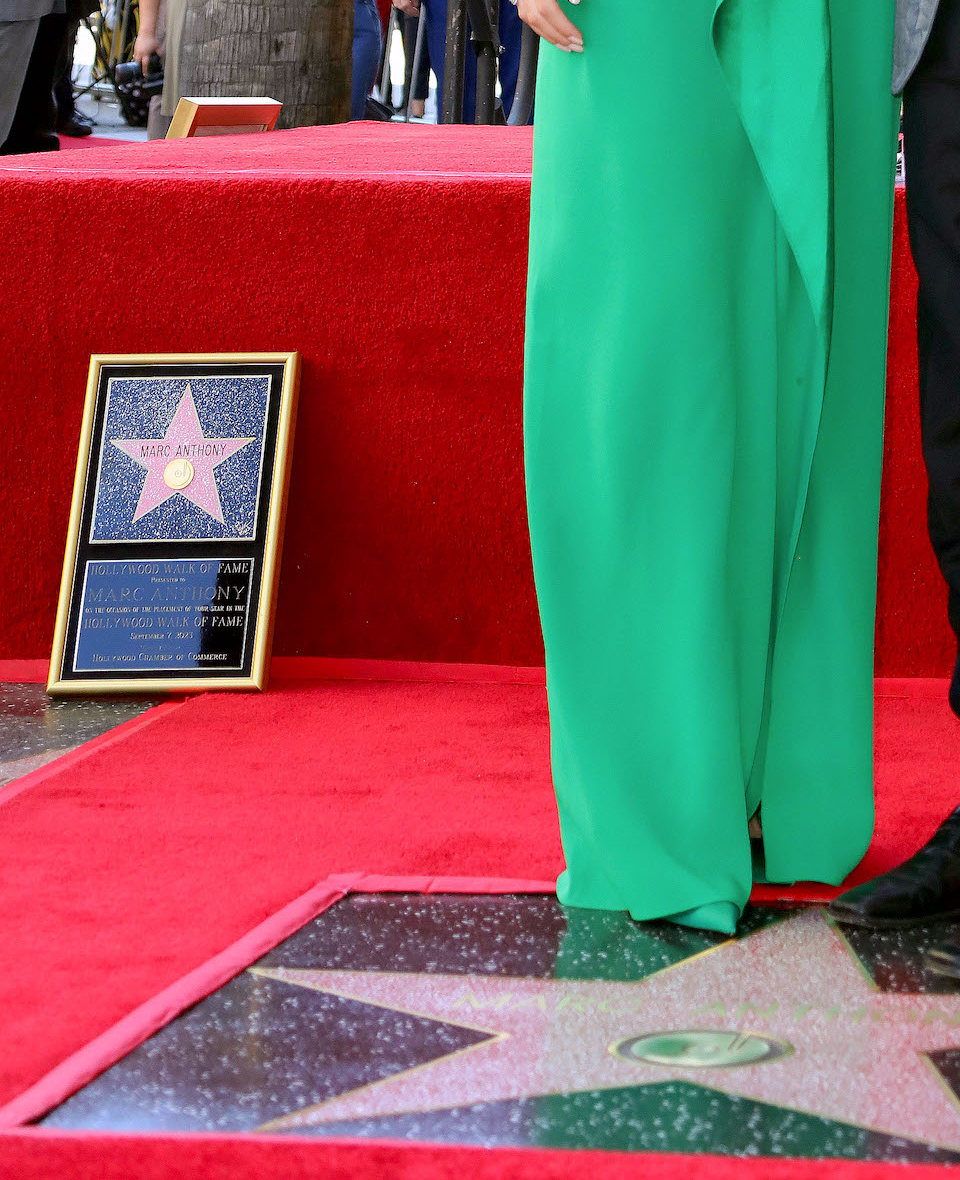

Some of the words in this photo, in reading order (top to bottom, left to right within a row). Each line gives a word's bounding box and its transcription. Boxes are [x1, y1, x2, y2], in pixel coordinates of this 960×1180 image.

[140, 445, 171, 457] MARC
[175, 444, 226, 456] ANTHONY
[90, 564, 160, 575] HOLLYWOOD
[164, 563, 195, 573] WALK
[200, 563, 213, 573] OF
[218, 562, 248, 573] FAME
[88, 588, 144, 602] MARC
[151, 586, 245, 600] ANTHONY
[84, 618, 152, 628] HOLLYWOOD
[157, 617, 189, 627] WALK
[193, 616, 207, 627] OF
[211, 616, 244, 627] FAME
